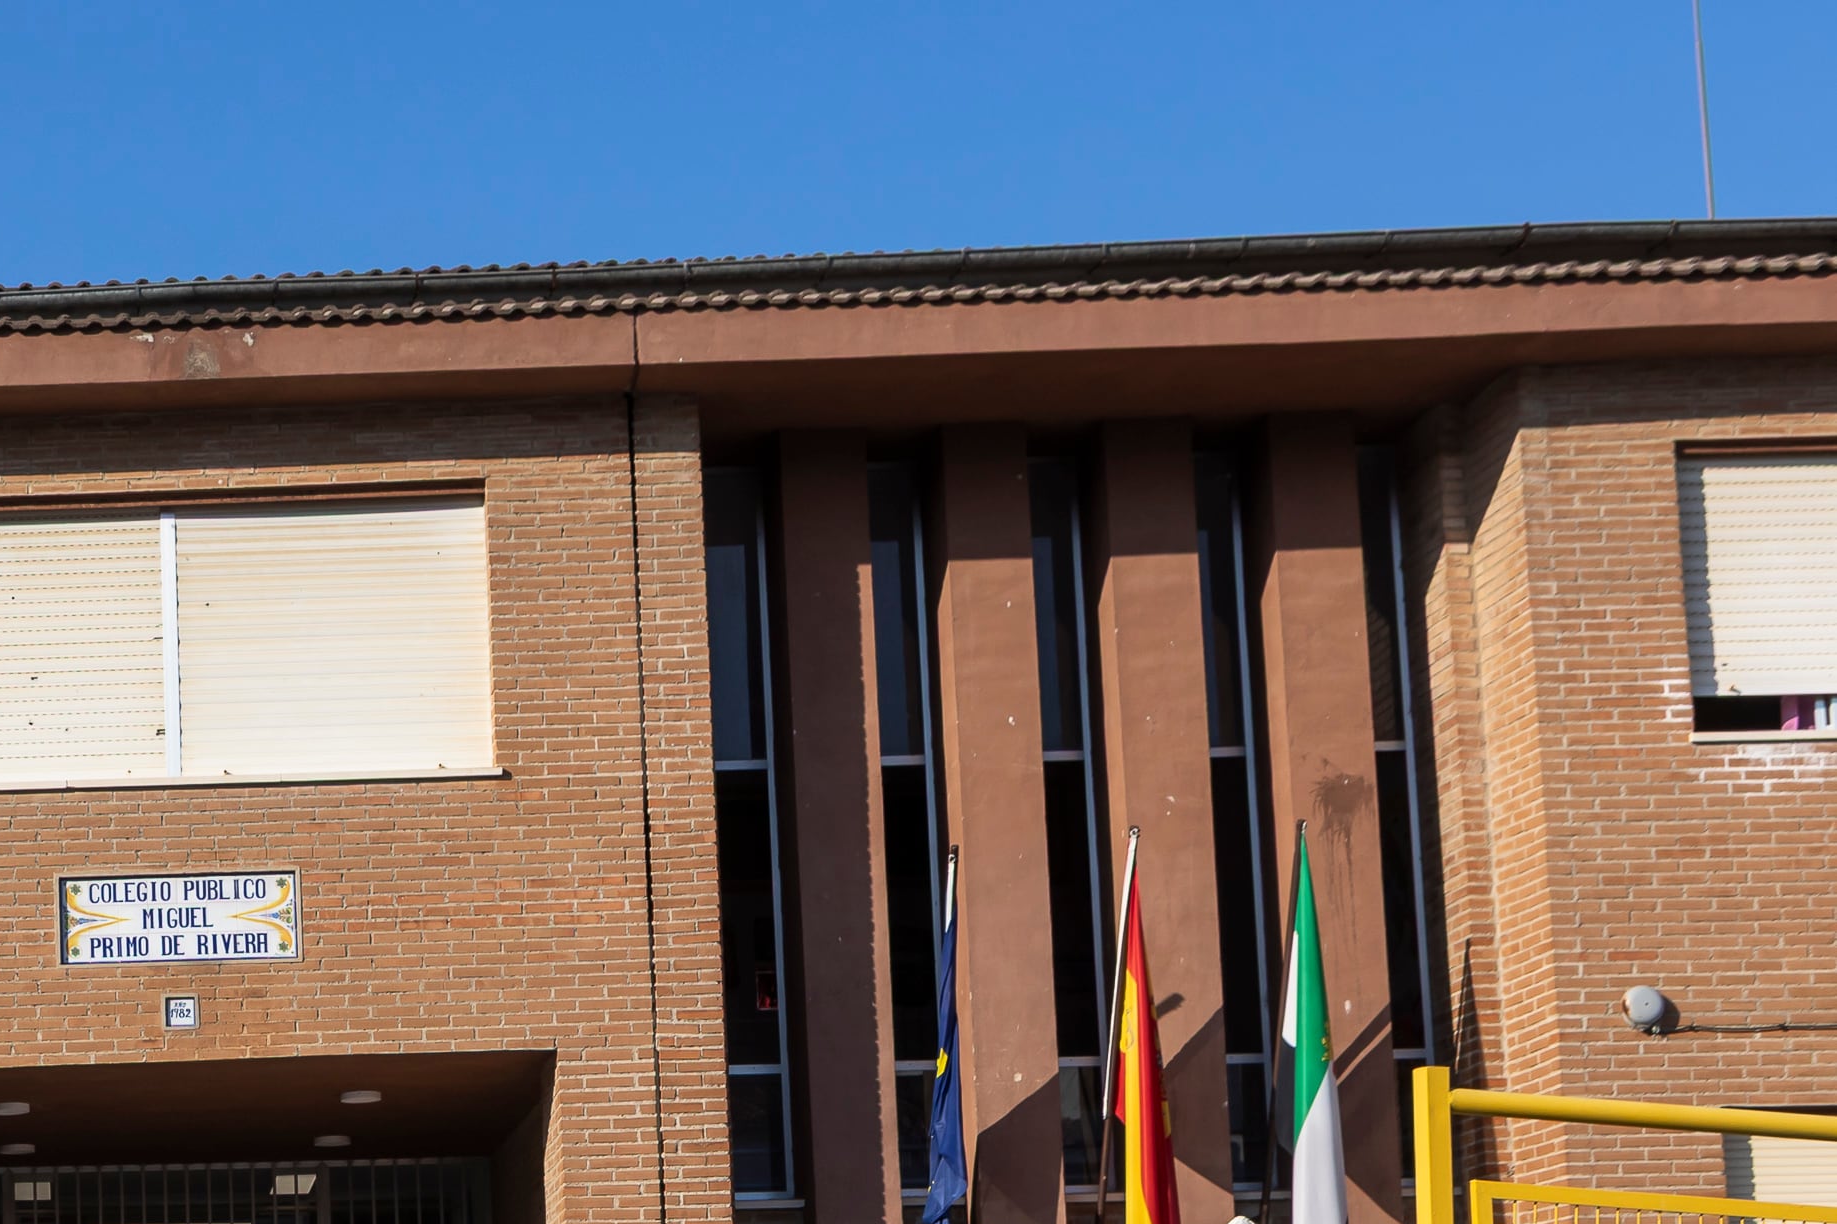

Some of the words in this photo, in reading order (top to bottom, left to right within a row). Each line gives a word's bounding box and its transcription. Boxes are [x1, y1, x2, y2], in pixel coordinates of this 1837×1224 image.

[89, 881, 171, 904] COLEGIO
[183, 878, 266, 900] PUBLICO
[142, 907, 214, 930] MIGUEL
[90, 935, 149, 958] PRIMO
[161, 934, 185, 956] DE
[197, 933, 268, 955] RIVERA
[171, 1008, 191, 1019] 1982
